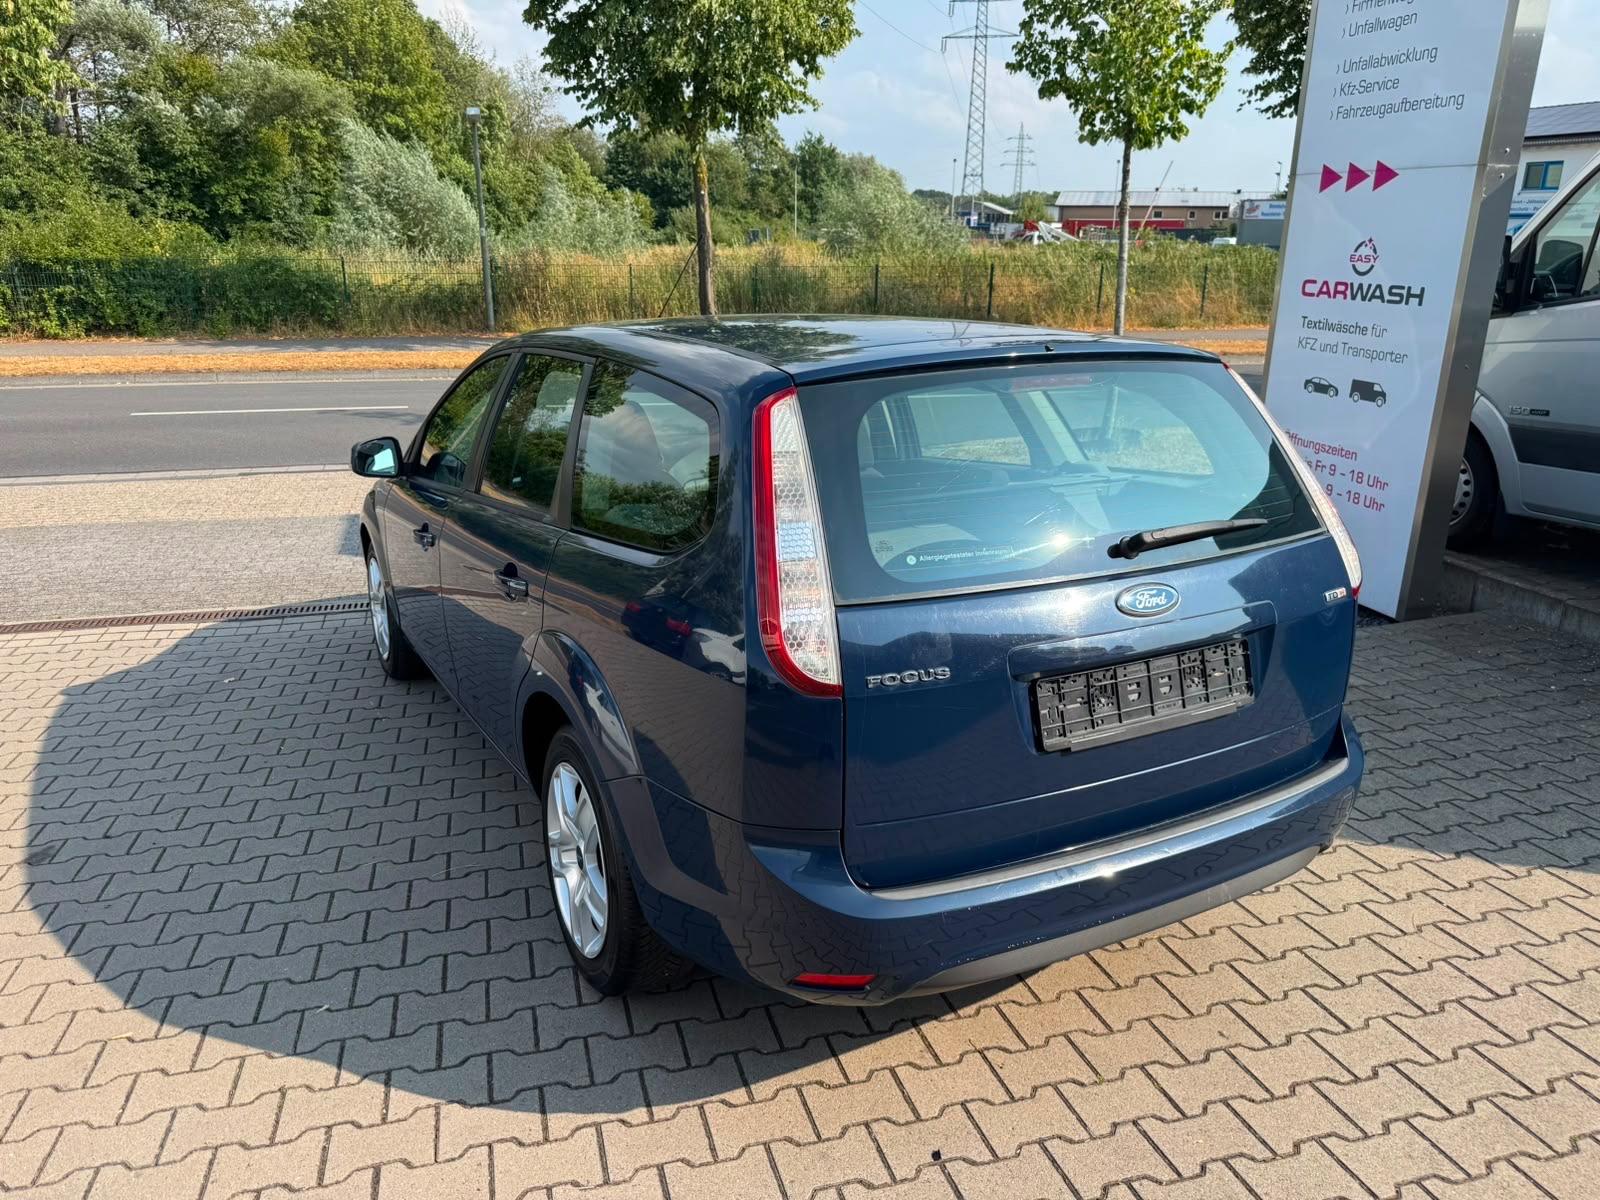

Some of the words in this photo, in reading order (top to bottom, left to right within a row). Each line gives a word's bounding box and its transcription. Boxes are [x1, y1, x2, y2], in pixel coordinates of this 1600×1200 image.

[1348, 12, 1418, 37] Unfallwagen
[1342, 46, 1438, 74] Unfallabwicklung
[1339, 76, 1400, 97] Kfz-Service
[1336, 93, 1465, 120] Fahrzeugaufbereitung
[1349, 254, 1380, 264] EASY
[1301, 279, 1426, 307] CARWASH
[1301, 315, 1368, 336] Textilwäsche
[1370, 323, 1388, 338] für
[1297, 336, 1318, 351] KFZ
[1319, 341, 1339, 354] und
[1341, 342, 1408, 364] Transporter
[1315, 459, 1327, 473] Fr
[1328, 463, 1337, 477] 9
[1349, 469, 1364, 485] 18
[1367, 474, 1389, 491] Uhr
[1325, 483, 1333, 497] 9
[1346, 490, 1361, 505] 18
[1363, 495, 1385, 512] Uhr
[1136, 589, 1167, 609] Ford
[865, 667, 951, 689] FOCUS
